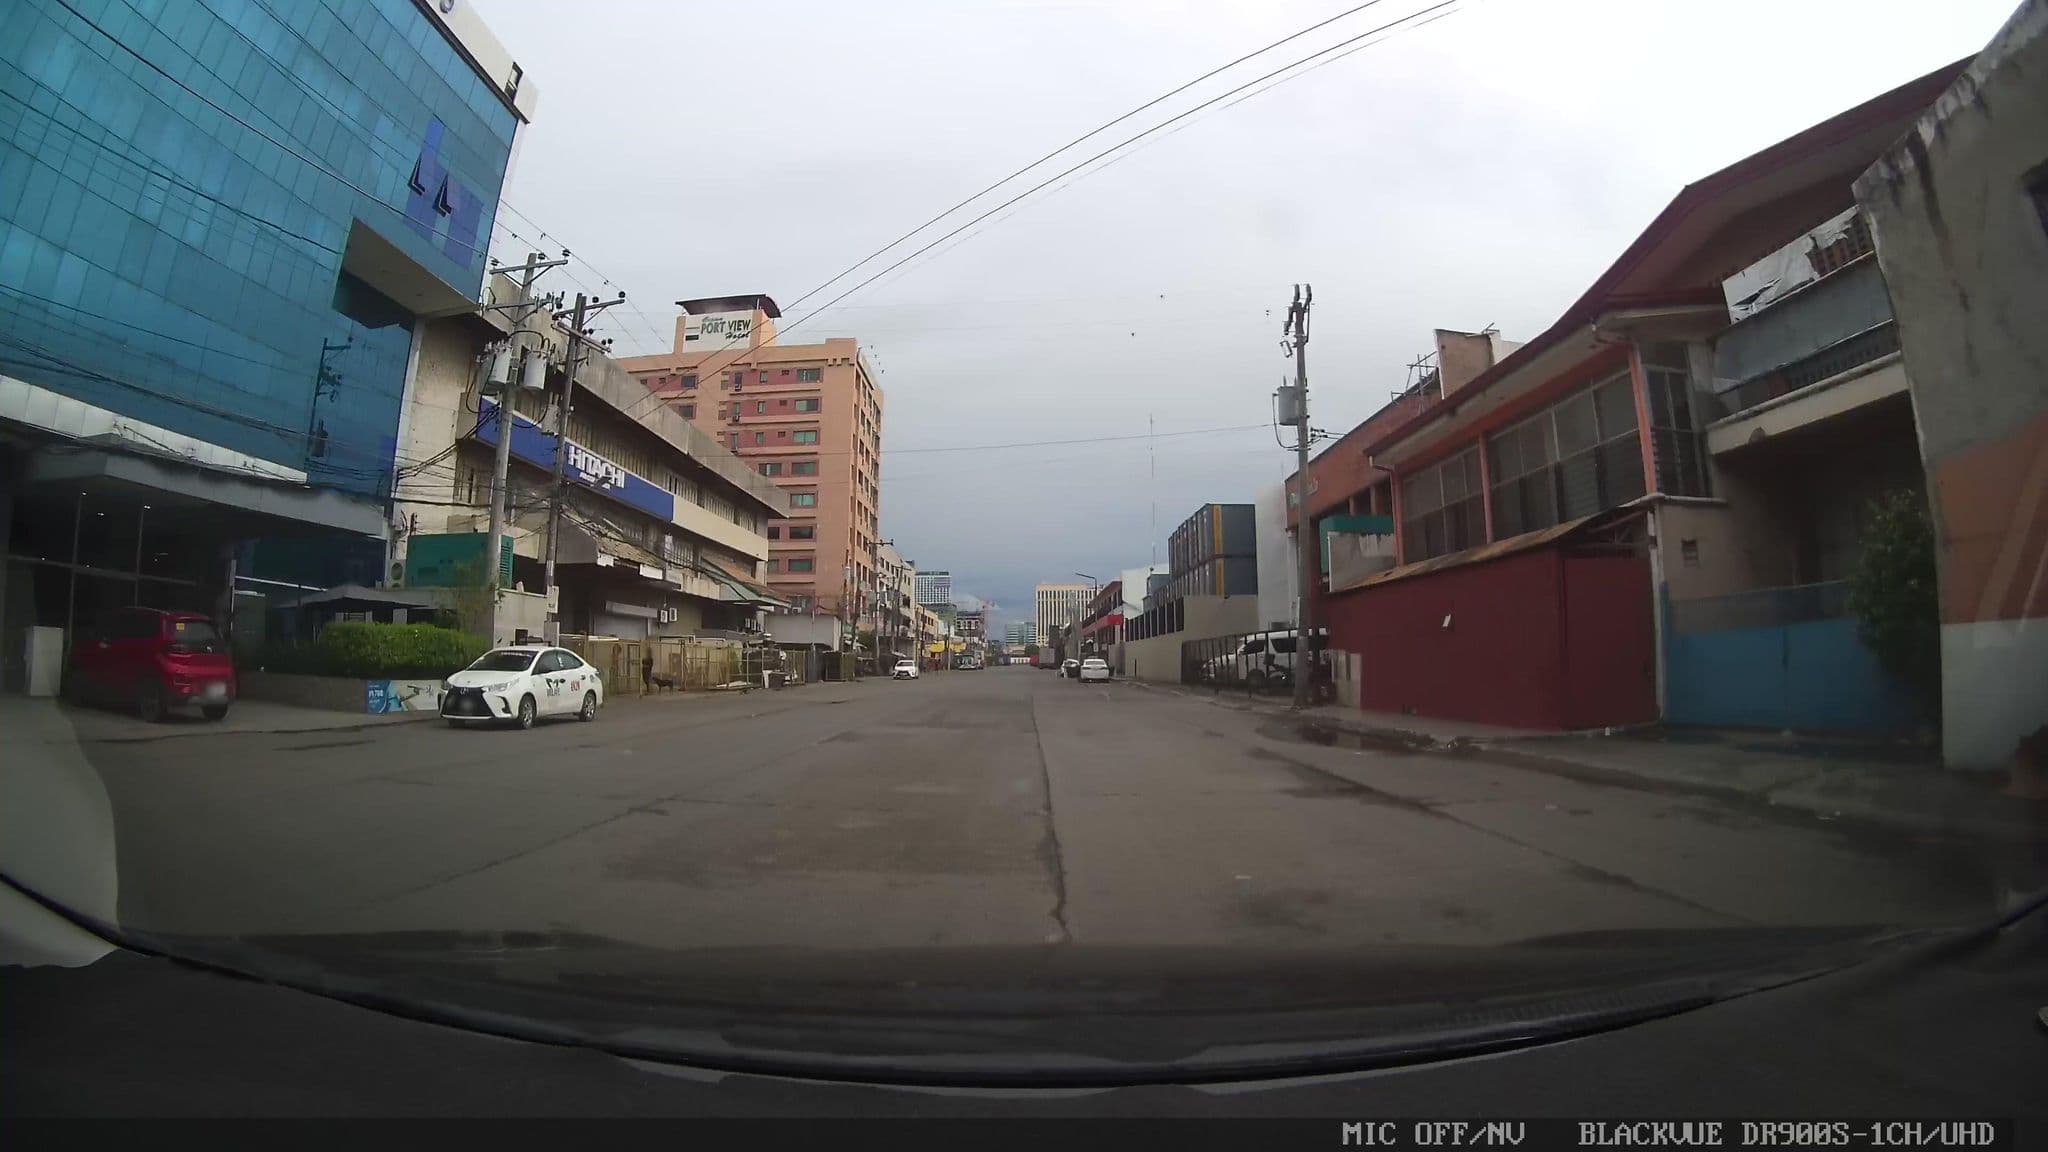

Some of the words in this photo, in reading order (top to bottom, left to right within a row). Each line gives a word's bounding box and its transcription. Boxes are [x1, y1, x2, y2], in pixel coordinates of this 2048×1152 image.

[700, 321, 726, 334] PORT
[727, 319, 752, 332] VIEW
[568, 445, 625, 489] HITACHI
